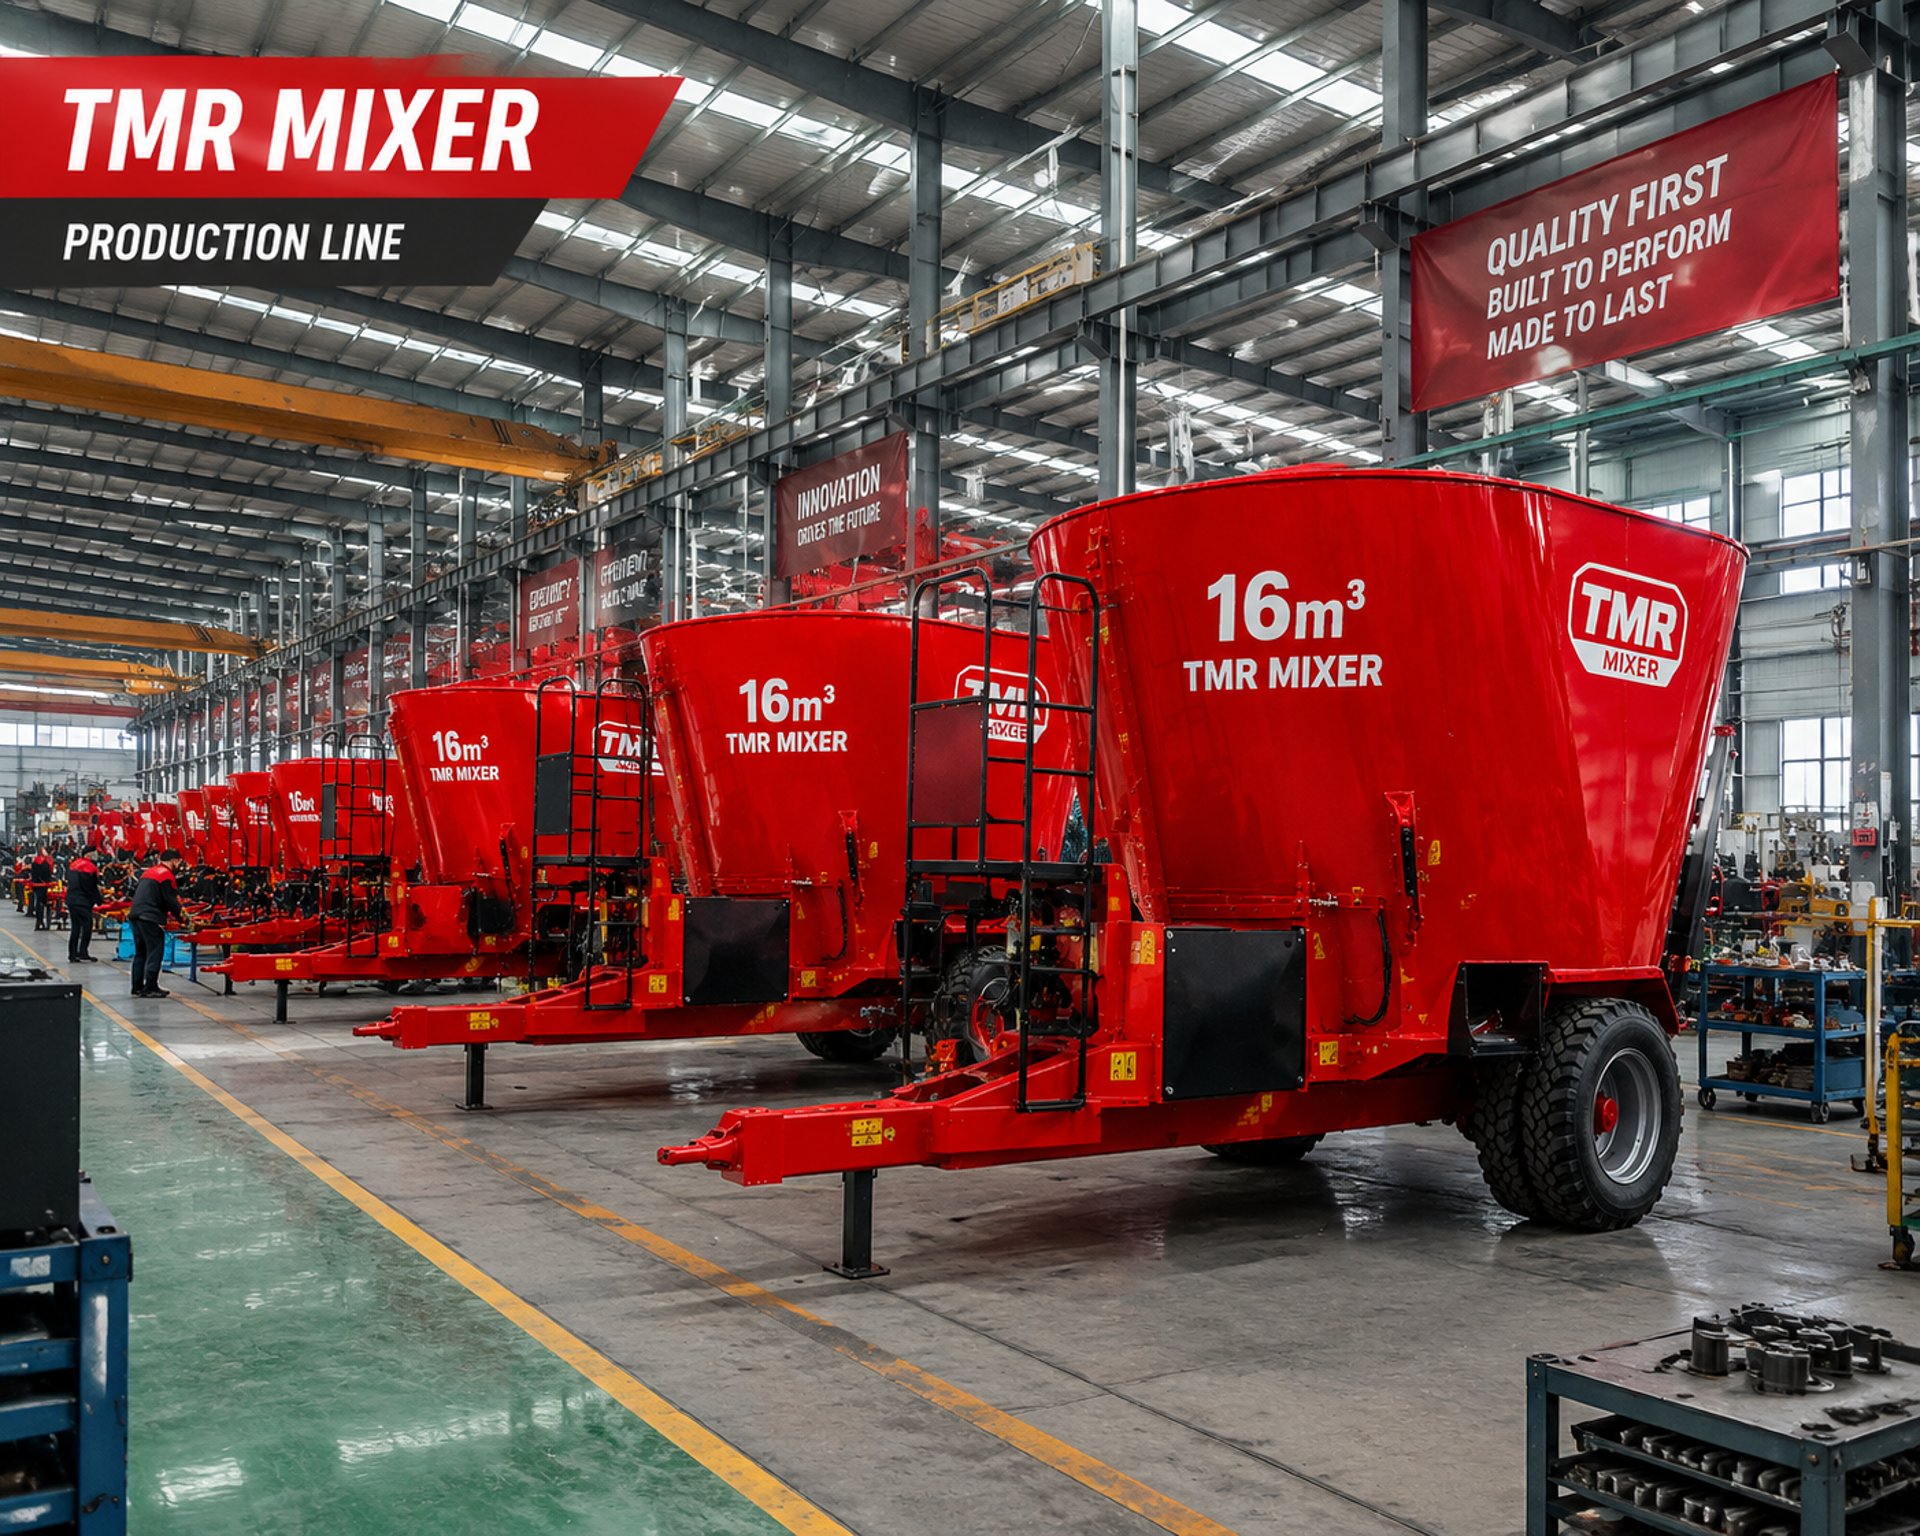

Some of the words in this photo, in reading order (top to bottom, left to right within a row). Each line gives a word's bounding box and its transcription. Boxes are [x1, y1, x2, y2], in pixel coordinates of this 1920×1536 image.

[1487, 194, 1620, 276] QUALITY
[1627, 153, 1729, 227] FIRST
[1487, 269, 1555, 320] BUILT
[1561, 257, 1594, 295] TO
[1600, 208, 1732, 283] PERFORM
[1487, 311, 1557, 360] MADE
[1563, 300, 1596, 338] TO
[1602, 273, 1674, 326] LAST
[797, 463, 881, 521] INNOVATION
[1581, 581, 1678, 653] TMR
[1183, 658, 1258, 692] TMR
[1268, 654, 1383, 689] MIXER
[1602, 650, 1659, 681] MIXER
[725, 732, 771, 755] TMR
[777, 730, 848, 753] MIXER
[429, 767, 454, 782] TMR
[456, 766, 499, 782] MIXER
